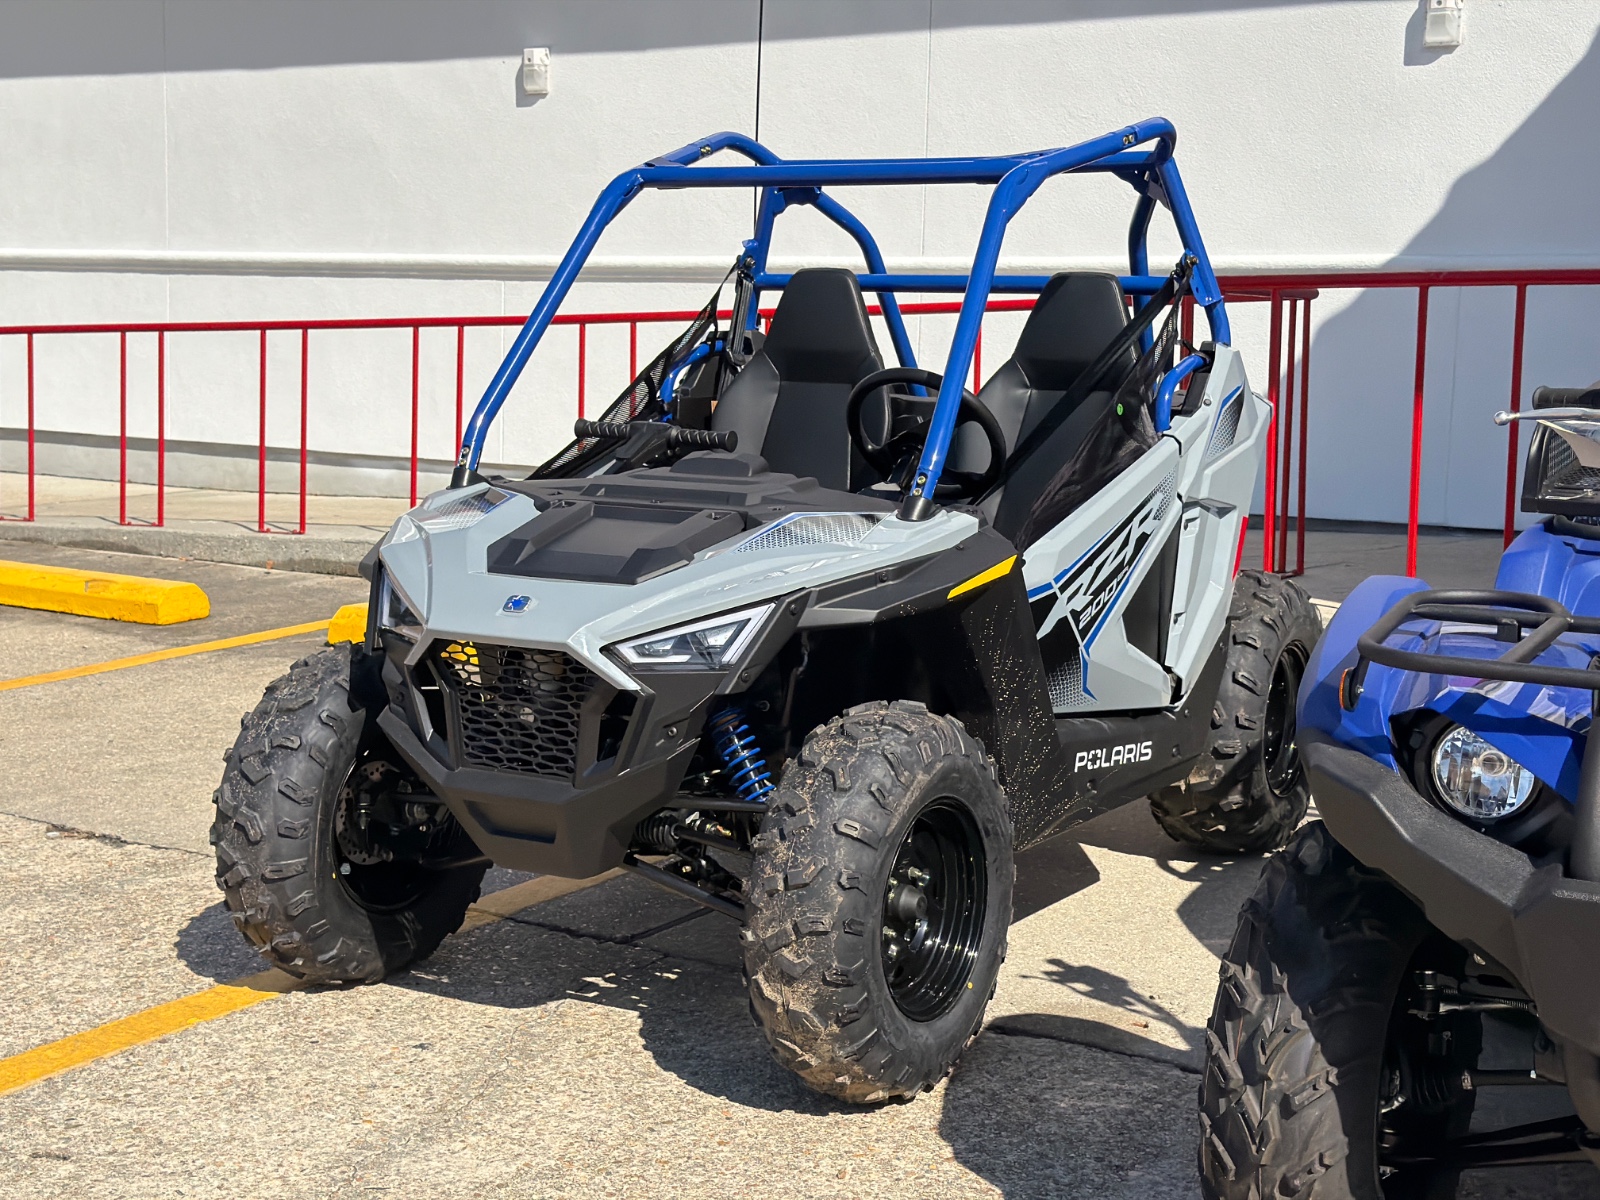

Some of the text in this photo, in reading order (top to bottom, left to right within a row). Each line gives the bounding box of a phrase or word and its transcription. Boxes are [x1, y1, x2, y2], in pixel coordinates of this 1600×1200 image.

[1036, 491, 1164, 640] RZR
[1079, 577, 1117, 630] 200
[1074, 741, 1152, 773] POLARIS
